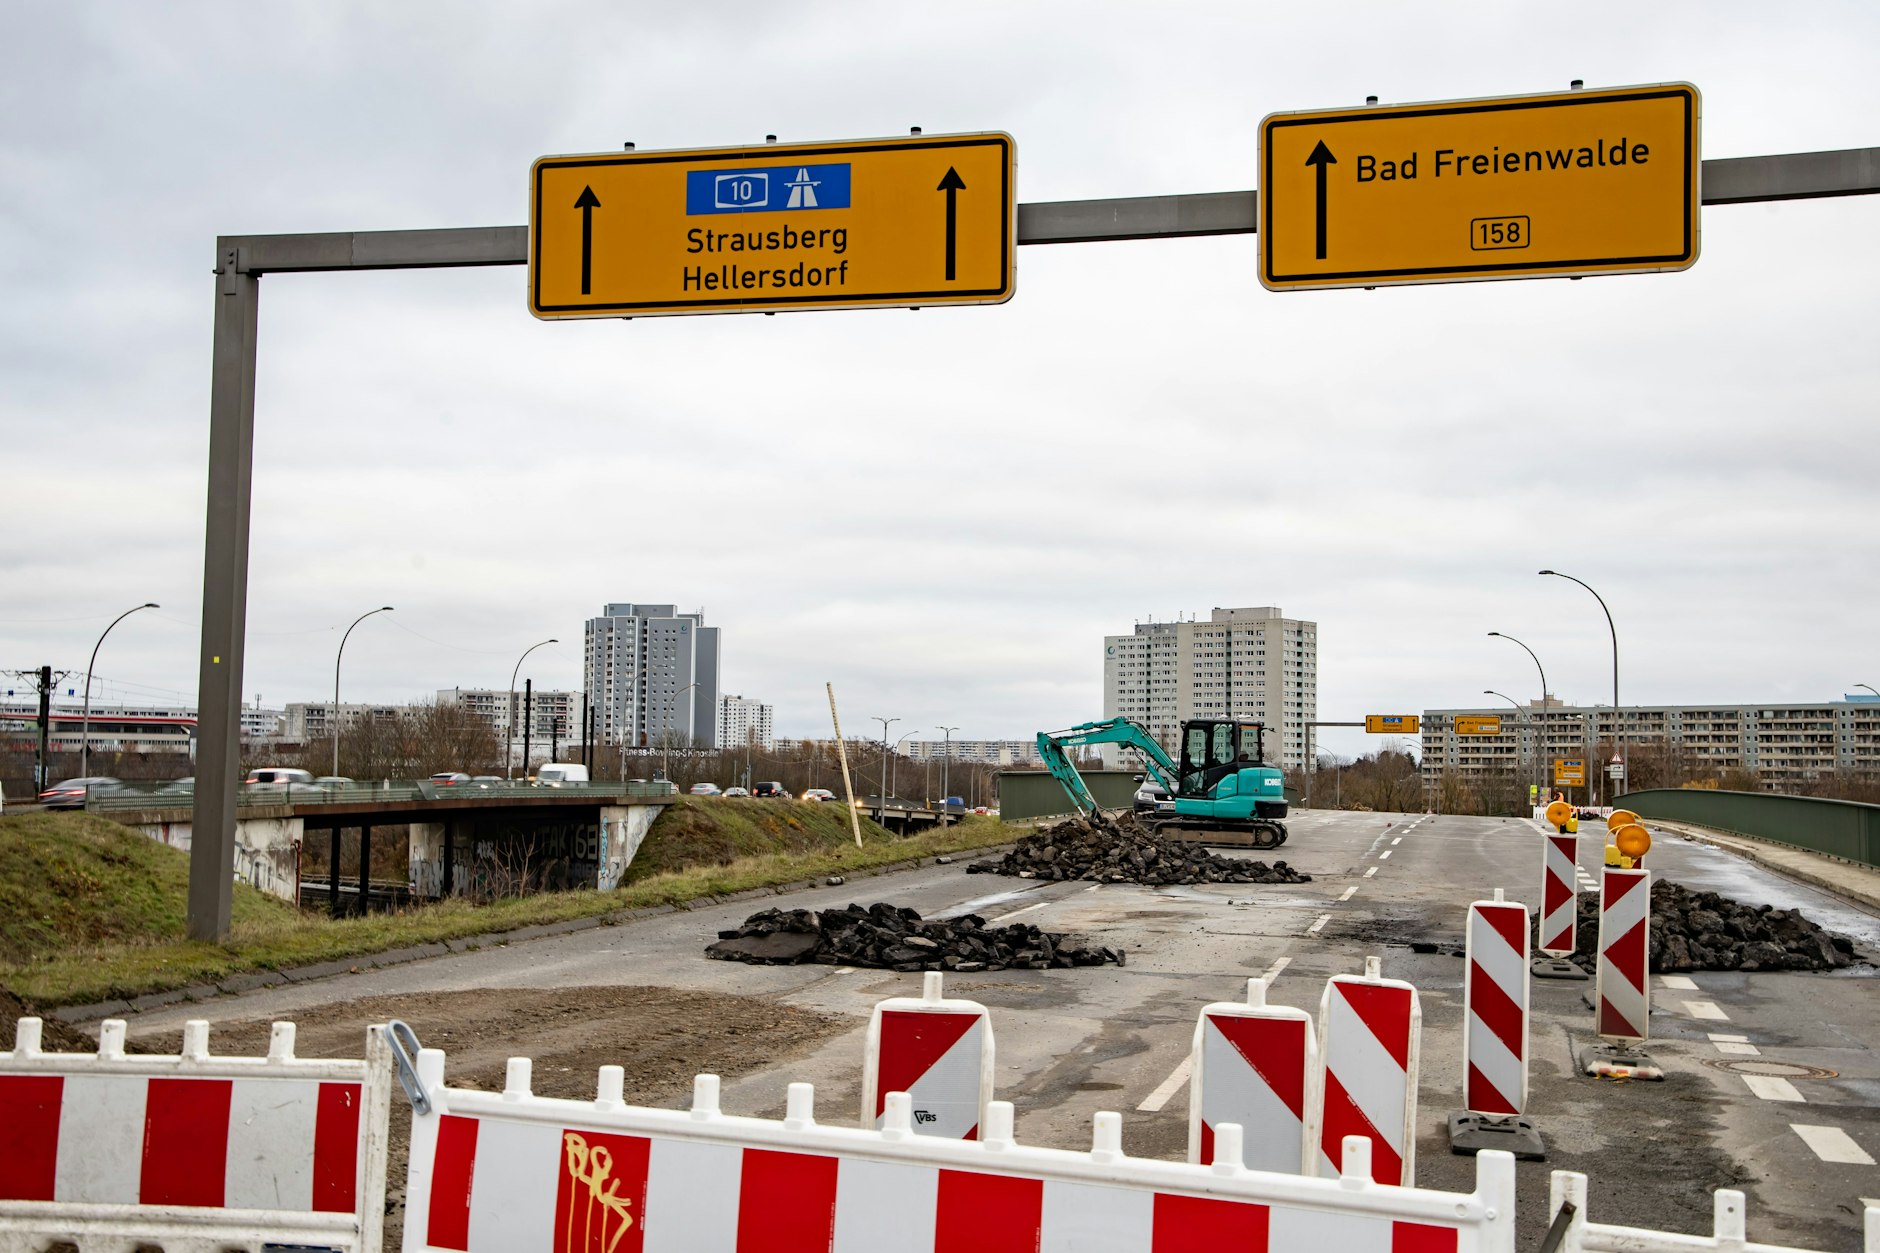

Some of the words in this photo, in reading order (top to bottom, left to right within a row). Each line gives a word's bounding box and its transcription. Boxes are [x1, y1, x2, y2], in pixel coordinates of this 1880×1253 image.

[1357, 152, 1418, 183] Bad
[1435, 137, 1650, 177] Freienwalde
[731, 180, 752, 202] 10
[686, 224, 848, 254] Strausberg
[1480, 221, 1520, 245] 158
[683, 260, 848, 291] Hellersdorf
[917, 1112, 937, 1122] VBS
